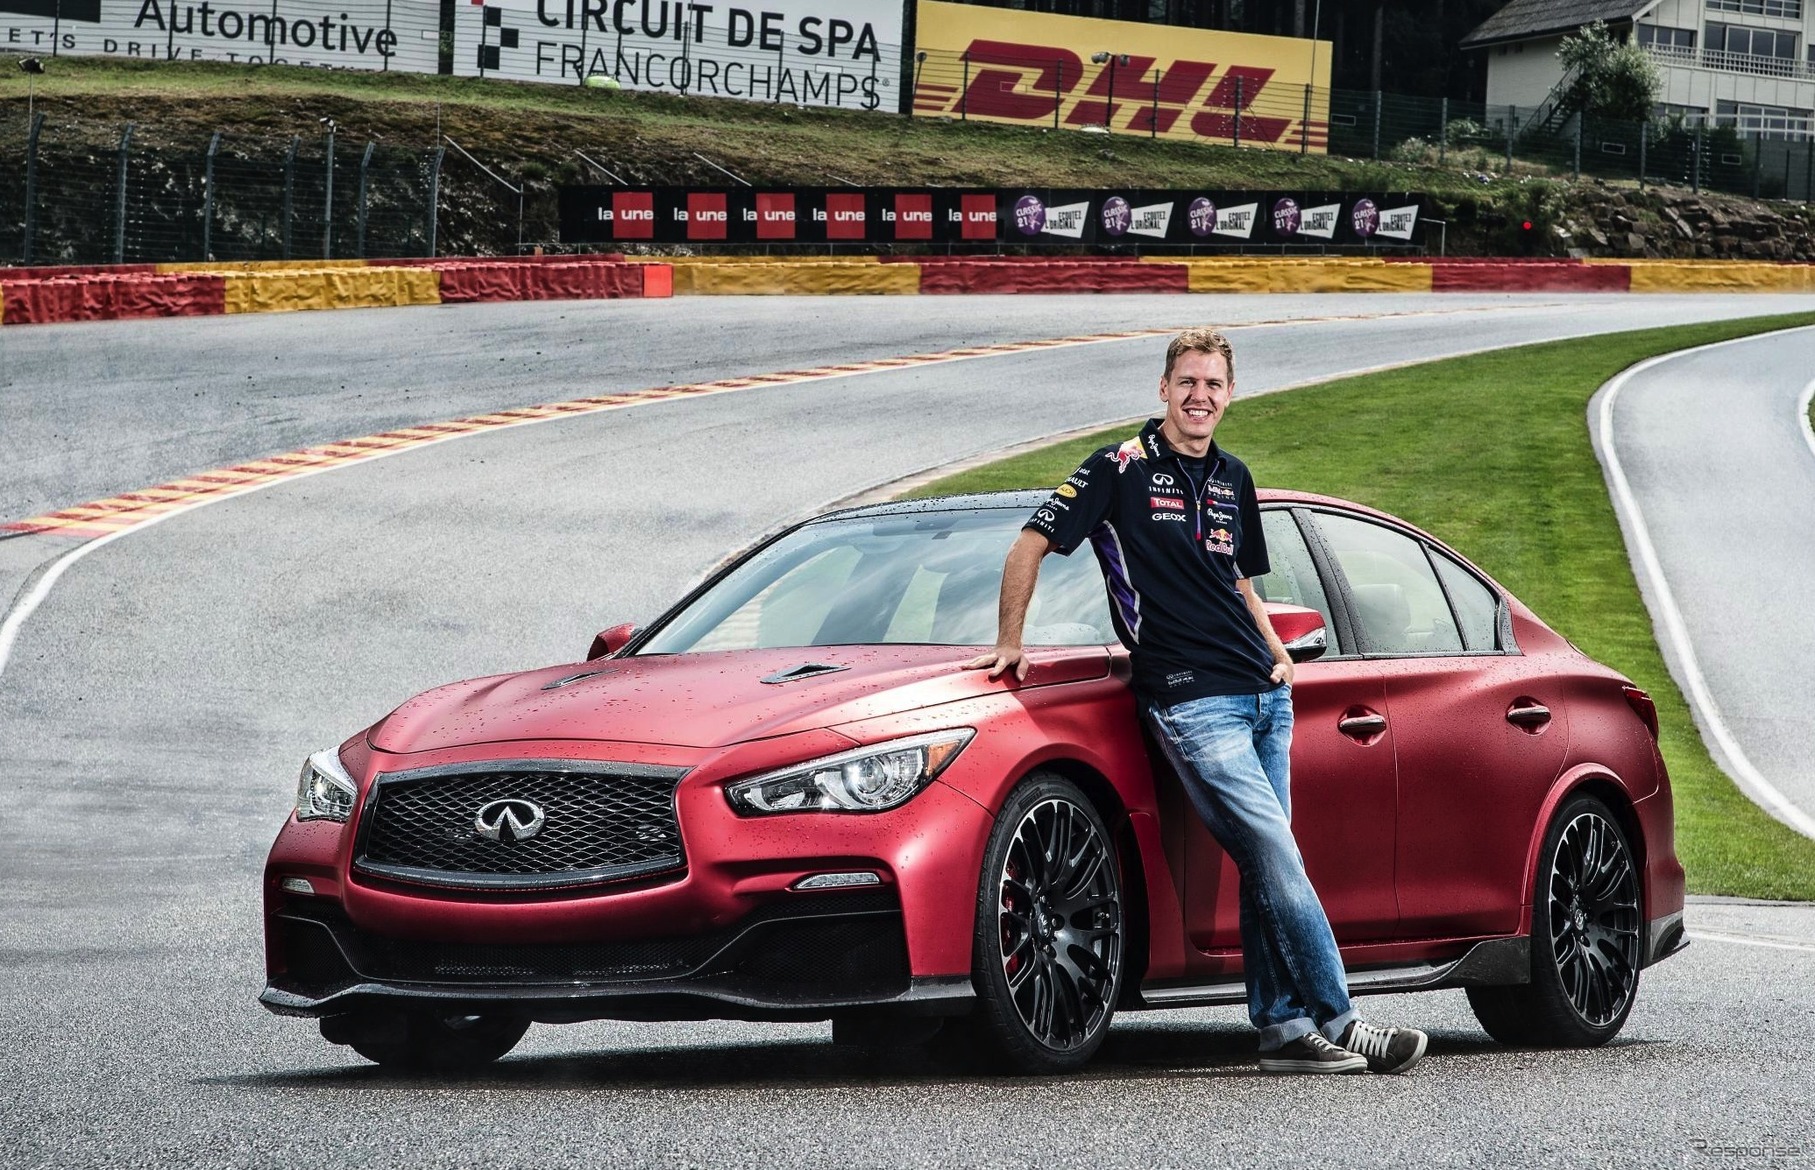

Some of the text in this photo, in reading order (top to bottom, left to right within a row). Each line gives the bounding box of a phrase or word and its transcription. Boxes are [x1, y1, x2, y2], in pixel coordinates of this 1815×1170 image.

[134, 0, 398, 57] Automotive
[537, 0, 881, 62] CIRCUIT DE SPA
[537, 41, 880, 109] FRANCORCHAMPS
[951, 39, 1292, 143] DHL
[598, 207, 653, 220] la une
[674, 208, 727, 221] la une
[743, 208, 795, 221] la une
[813, 208, 865, 221] la une
[882, 208, 932, 222] la une
[949, 208, 997, 222] la une
[1016, 203, 1042, 217] CLASSIC
[1103, 204, 1129, 218] CLASSIC
[1190, 205, 1213, 219] CLASSIC
[1274, 206, 1298, 219] CLASSIC
[1353, 207, 1377, 220] CLASSIC
[1017, 216, 1028, 227] 21
[1104, 217, 1116, 228] 21
[1191, 218, 1201, 229] 21
[1275, 219, 1286, 229] 21
[1354, 219, 1365, 229] 21
[1155, 498, 1183, 508] TOTAL
[1152, 512, 1187, 522] GEOX
